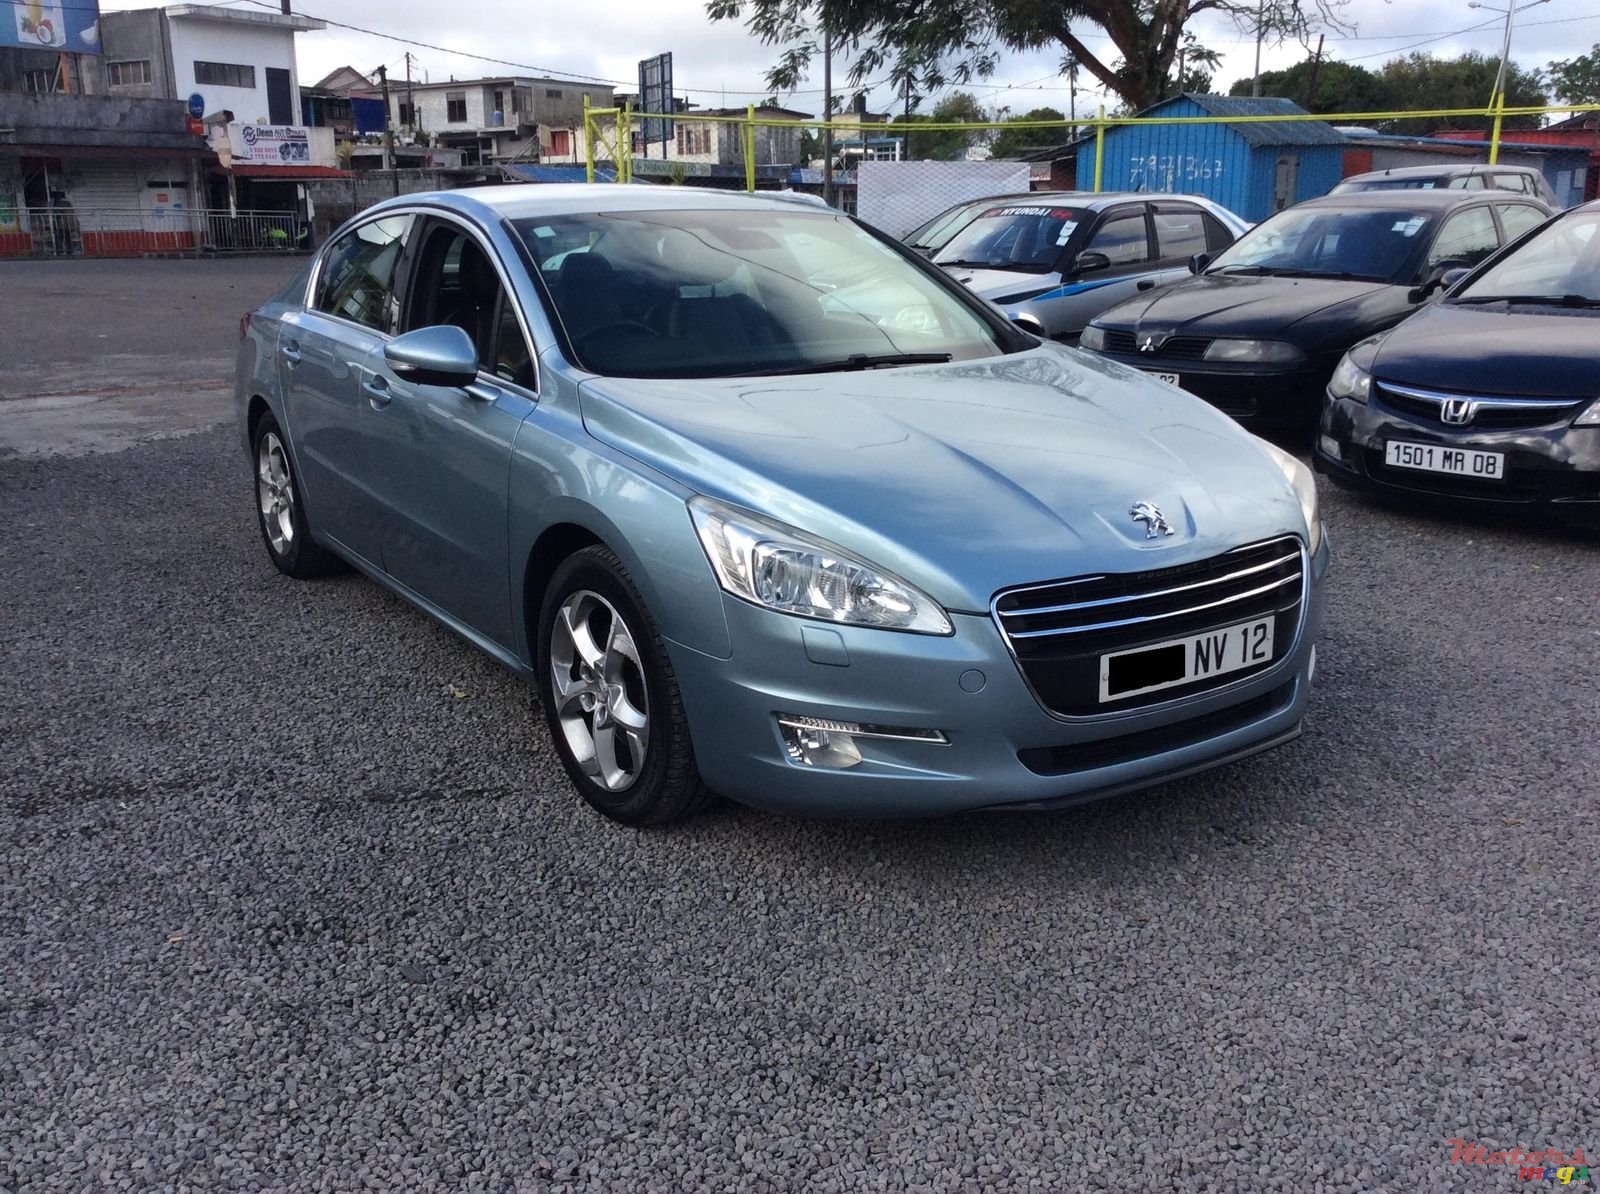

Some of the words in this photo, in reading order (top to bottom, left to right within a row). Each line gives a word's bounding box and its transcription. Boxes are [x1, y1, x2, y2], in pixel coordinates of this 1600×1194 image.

[1000, 207, 1052, 216] HYUNDAI
[1394, 444, 1434, 468] 1501
[1442, 450, 1465, 472] MR
[1473, 454, 1497, 475] 08
[1194, 632, 1228, 676] NV
[1241, 622, 1268, 664] 12
